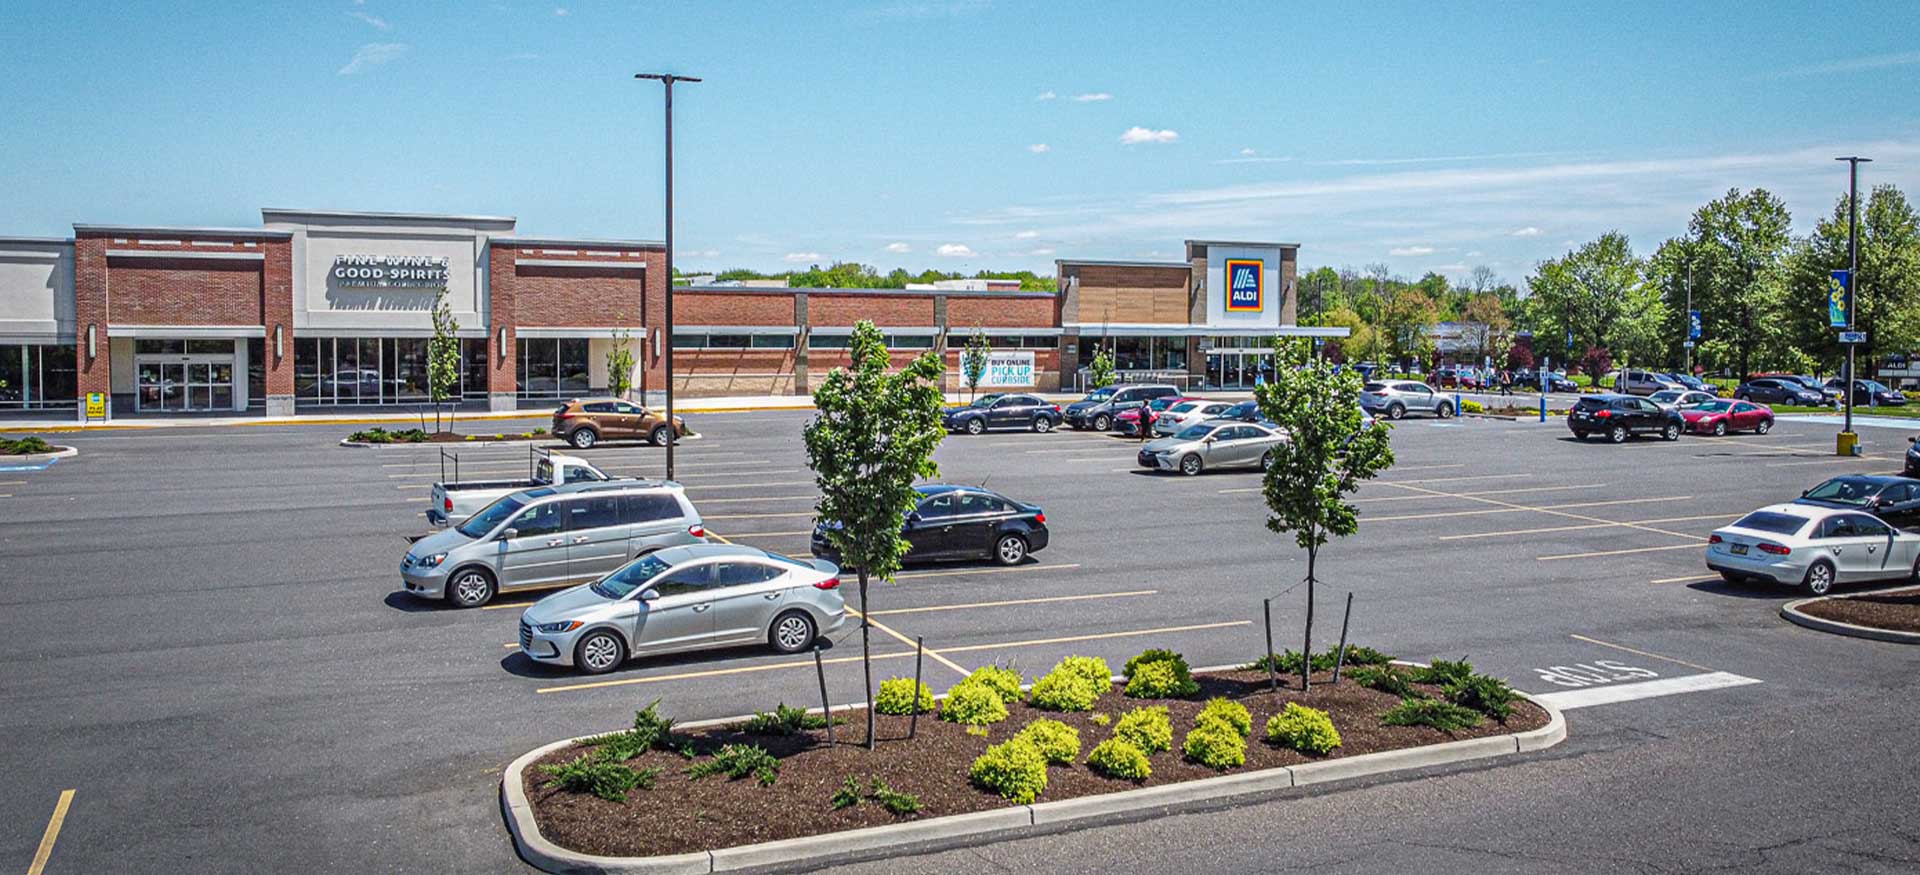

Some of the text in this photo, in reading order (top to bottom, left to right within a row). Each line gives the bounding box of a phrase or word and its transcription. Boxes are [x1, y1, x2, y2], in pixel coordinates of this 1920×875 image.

[335, 254, 377, 266] FINE
[386, 255, 433, 267] WINE
[335, 267, 449, 280] GOOD SPIRITS
[1233, 291, 1256, 300] ALDI
[991, 366, 1031, 375] PICK UP
[991, 376, 1030, 384] CURBSIDE
[1533, 660, 1659, 687] STOP
